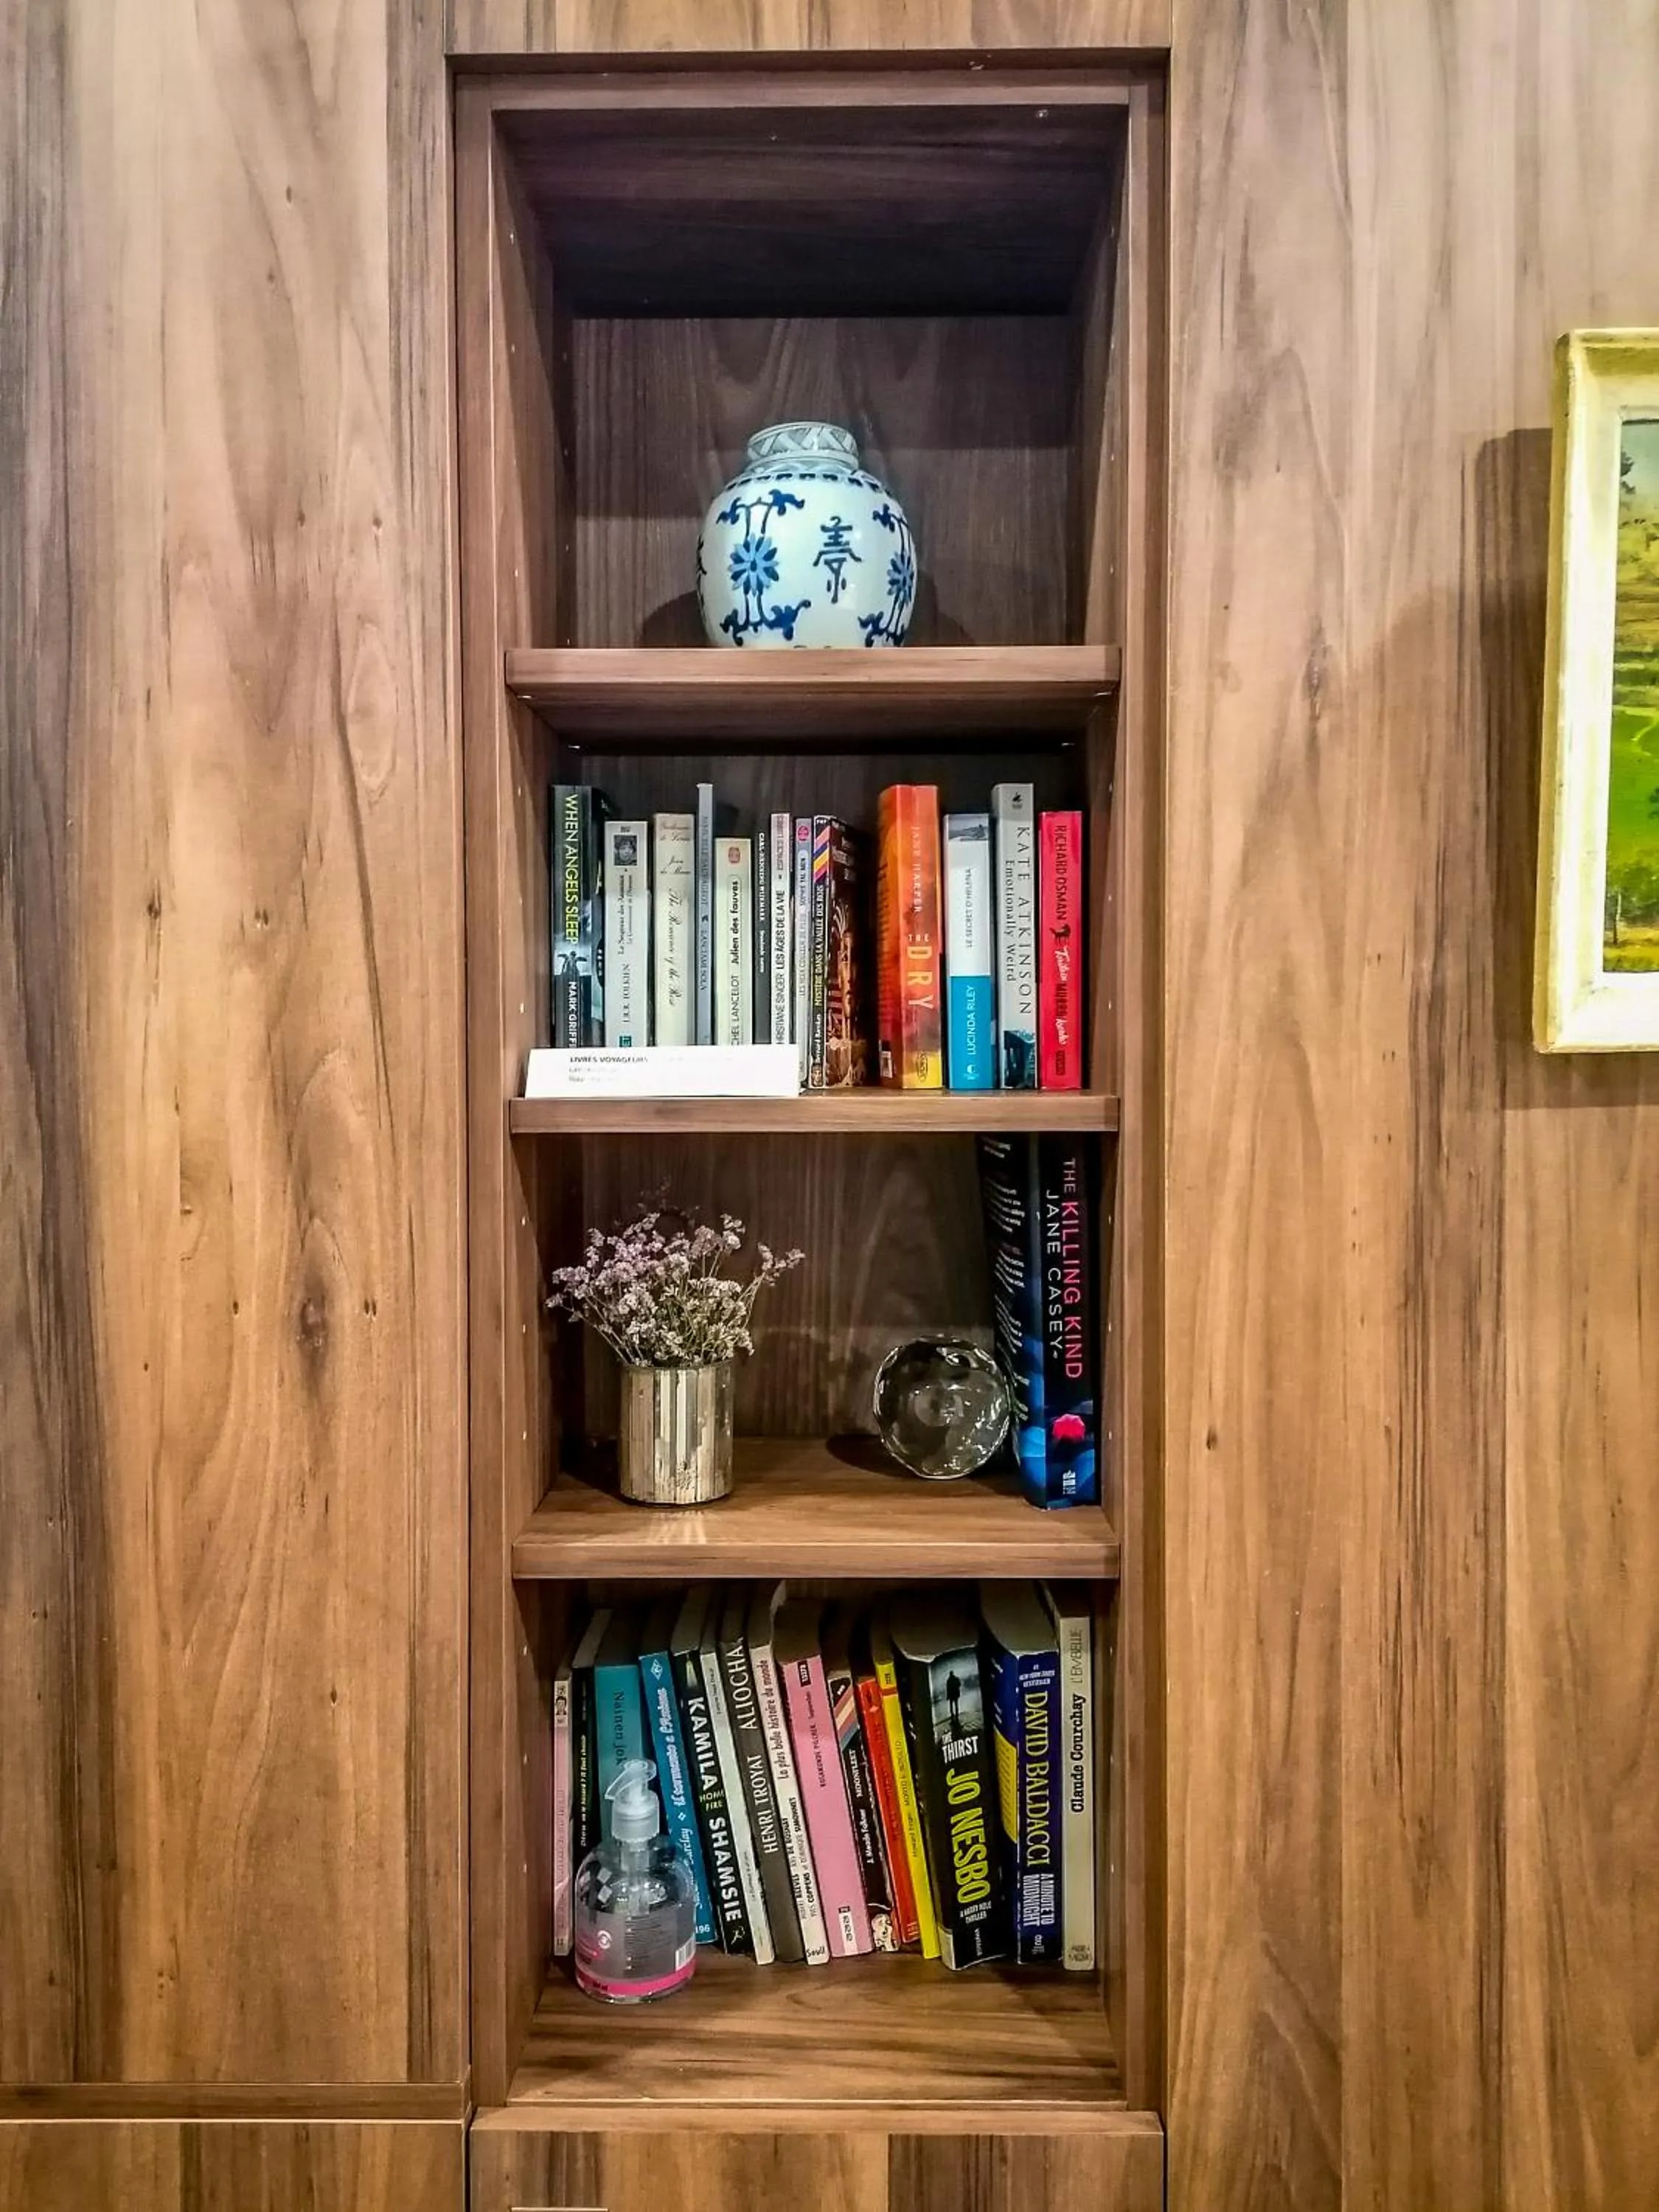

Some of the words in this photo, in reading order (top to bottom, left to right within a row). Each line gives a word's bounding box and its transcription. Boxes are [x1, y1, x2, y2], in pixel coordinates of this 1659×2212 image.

[565, 793, 580, 842] WHEN
[1017, 825, 1032, 881] KATE
[1054, 825, 1068, 874] RICHARD
[565, 846, 580, 903] ANGELS
[669, 888, 683, 907] The
[728, 880, 740, 914] fauves
[776, 891, 786, 904] VIE
[776, 904, 786, 916] LA
[1004, 860, 1016, 937] Emotionally
[1055, 877, 1068, 920] OSMAN
[565, 905, 580, 945] SLEEP
[668, 911, 683, 952] Romance
[728, 917, 739, 934] des
[776, 917, 786, 928] DE
[908, 933, 931, 942] THE
[728, 936, 740, 966] Julien
[773, 929, 786, 953] ÂGES
[1017, 897, 1032, 1015] ATKINSON
[664, 956, 678, 964] of
[669, 968, 681, 981] the
[776, 954, 786, 970] LES
[908, 946, 933, 1009] DRY
[1005, 943, 1018, 982] Weird
[567, 981, 577, 1011] MARK
[622, 964, 631, 999] TOLKIEN
[669, 984, 683, 1006] Rose
[728, 975, 740, 1023] LANCELOT
[776, 973, 786, 1004] SINGER
[967, 985, 976, 1010] RILEY
[567, 1014, 578, 1048] GRIFFI
[729, 1024, 740, 1046] CHEL
[967, 1012, 976, 1055] LUCINDA
[1062, 1157, 1077, 1193] THE
[1046, 1189, 1061, 1254] JANE
[1061, 1201, 1081, 1304] KILLING
[1064, 1316, 1082, 1379] KIND
[726, 1645, 757, 1731] ALIOCHA
[758, 1659, 773, 1687] monde
[615, 1691, 628, 1739] Nainen
[763, 1700, 780, 1730] histoire
[1023, 1691, 1048, 1756] DAVID
[1071, 1692, 1086, 1759] Courchay
[613, 1742, 625, 1766] jok
[769, 1731, 784, 1750] belle
[773, 1750, 789, 1767] plus
[942, 1735, 979, 1764] THIRST
[746, 1754, 768, 1805] TROYAT
[848, 1748, 864, 1798] MOONFLEET
[946, 1768, 981, 1805] JO
[1071, 1760, 1085, 1814] Claude
[688, 1697, 718, 1790] KAMILA
[709, 1816, 742, 1921] SHAMSIE
[706, 1800, 723, 1811] FIRE
[1025, 1758, 1051, 1867] BALDACCI
[757, 1809, 779, 1853] HENRI
[951, 1807, 992, 1904] NESBO
[802, 1873, 815, 1903] COPPENS
[1023, 1874, 1040, 1927] MIDNIGHT
[1040, 1913, 1055, 1925] TO
